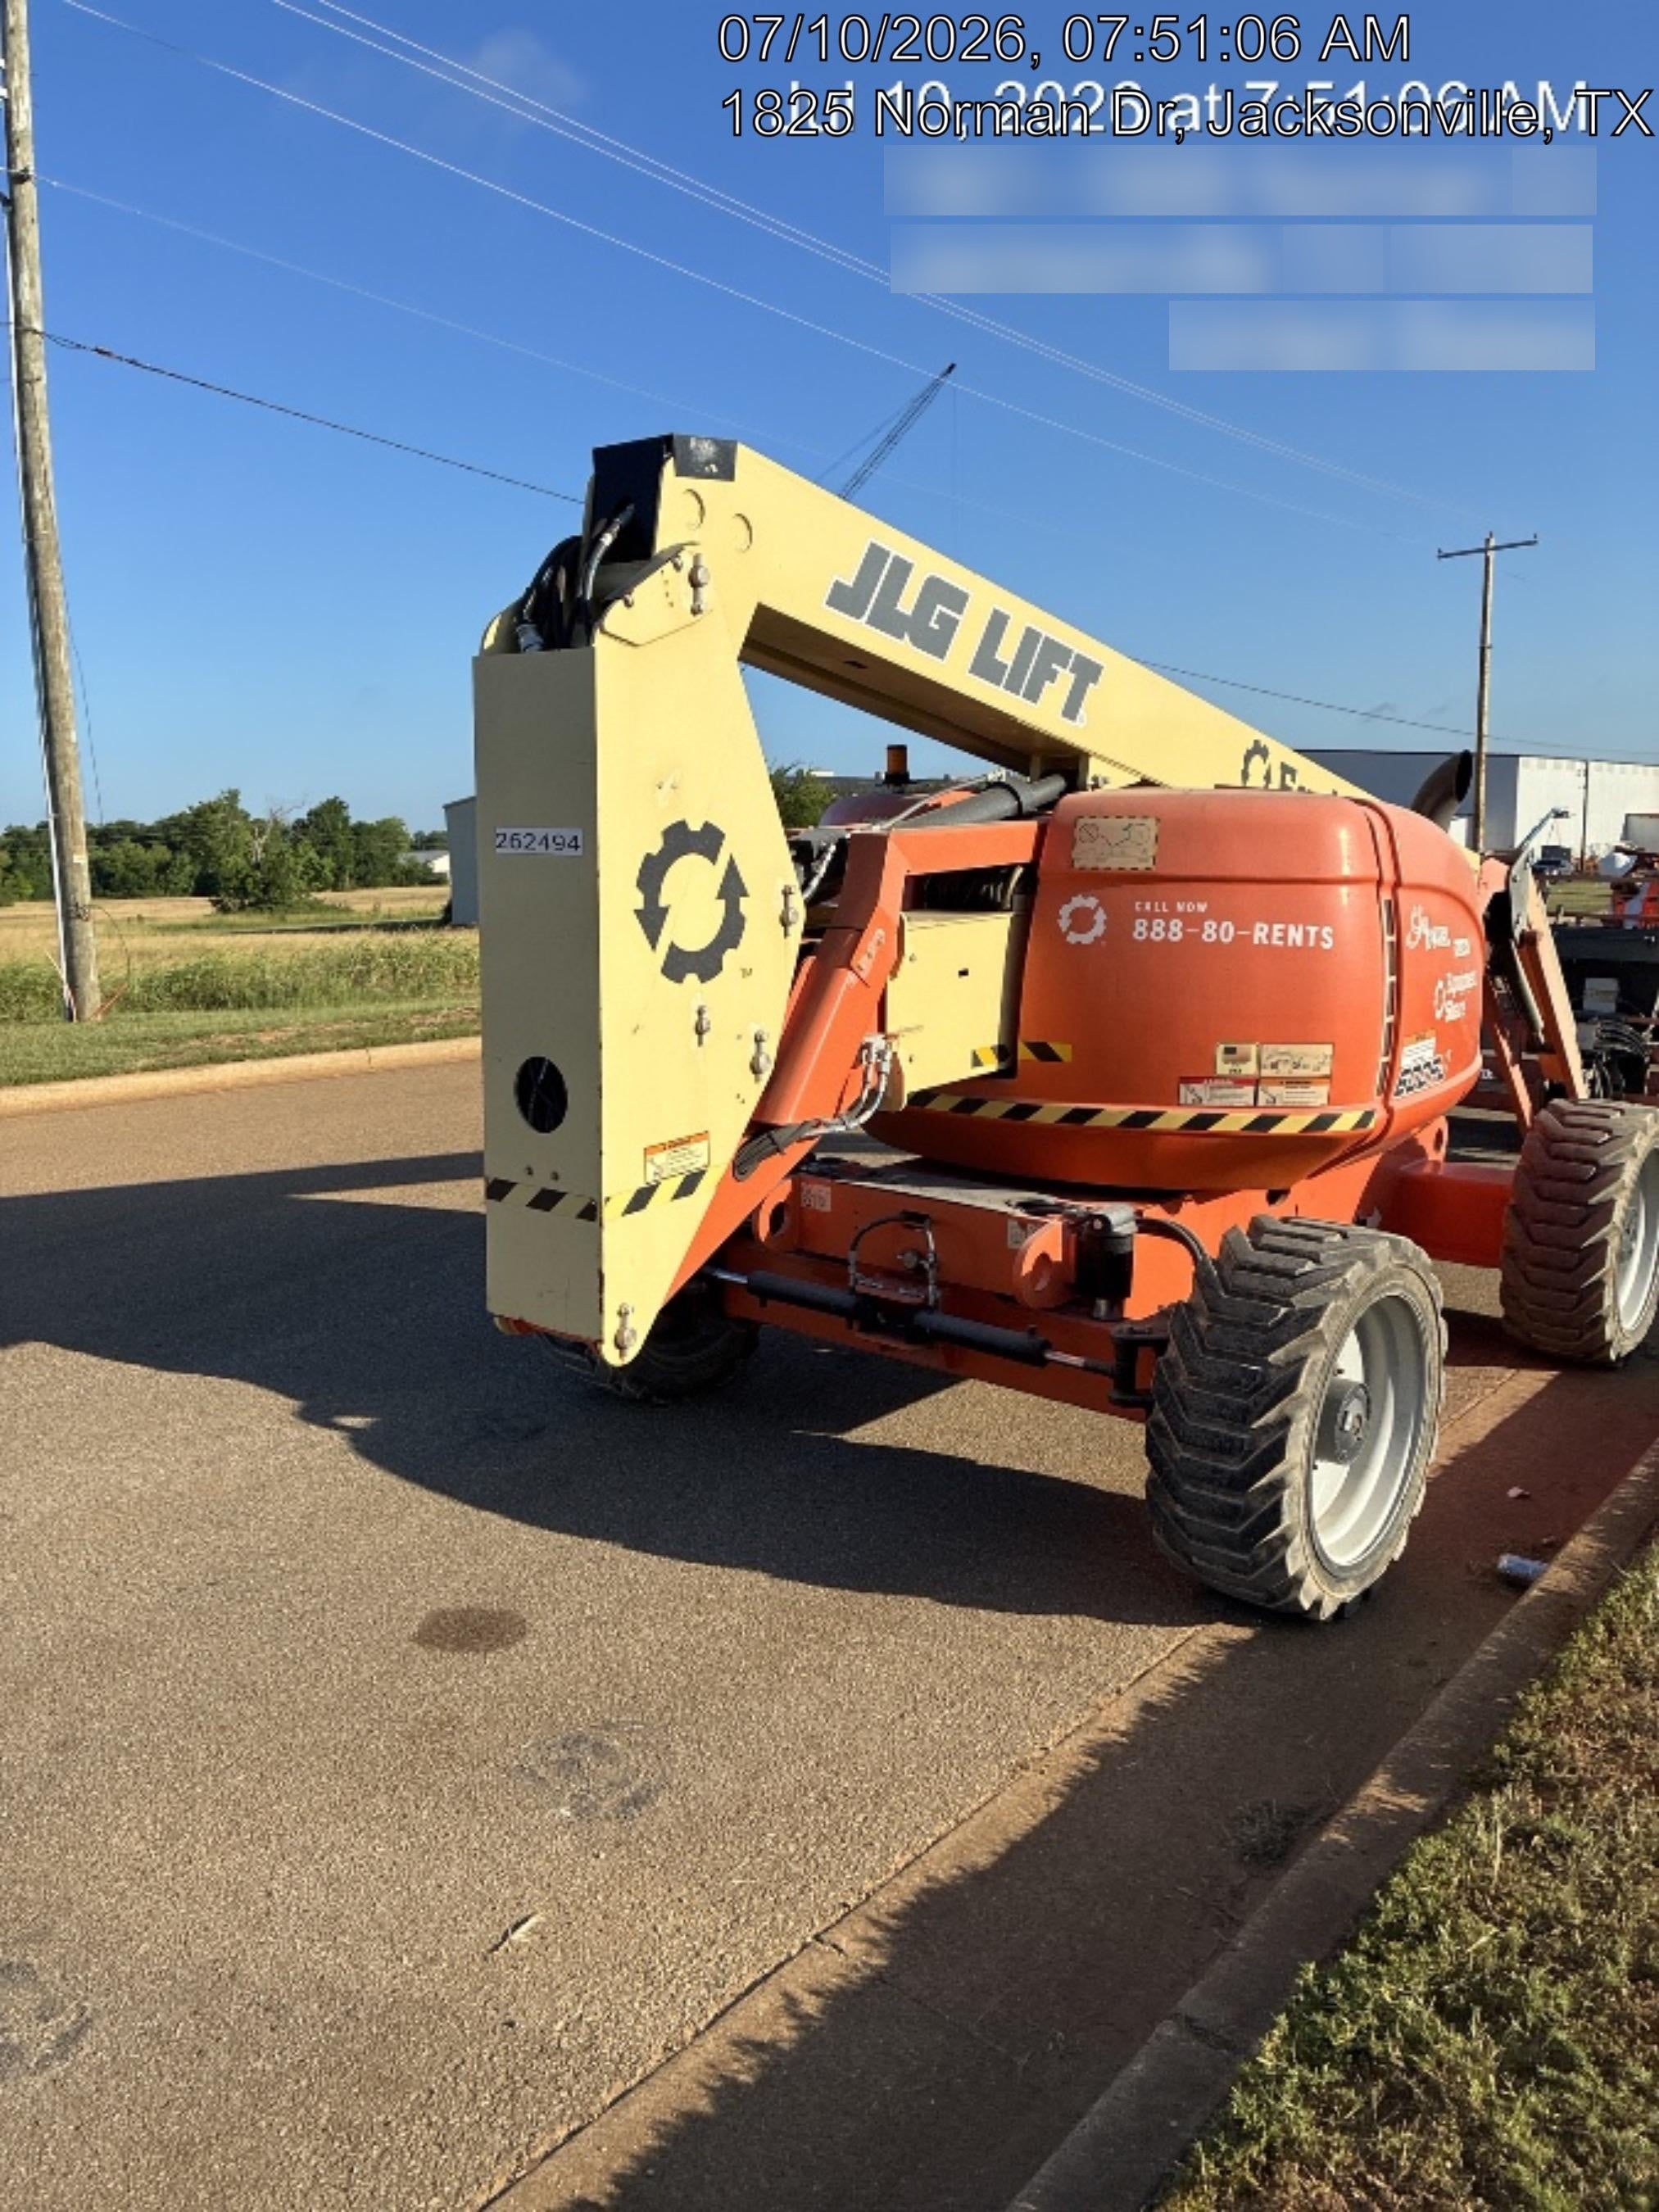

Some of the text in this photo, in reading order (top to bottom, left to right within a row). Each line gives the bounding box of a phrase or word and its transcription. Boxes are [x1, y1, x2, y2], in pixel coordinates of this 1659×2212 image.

[823, 538, 1105, 724] JLG LIFT
[496, 832, 581, 851] 262494
[1135, 901, 1208, 913] CALL NOW
[1132, 918, 1334, 950] 888-80-RENTS
